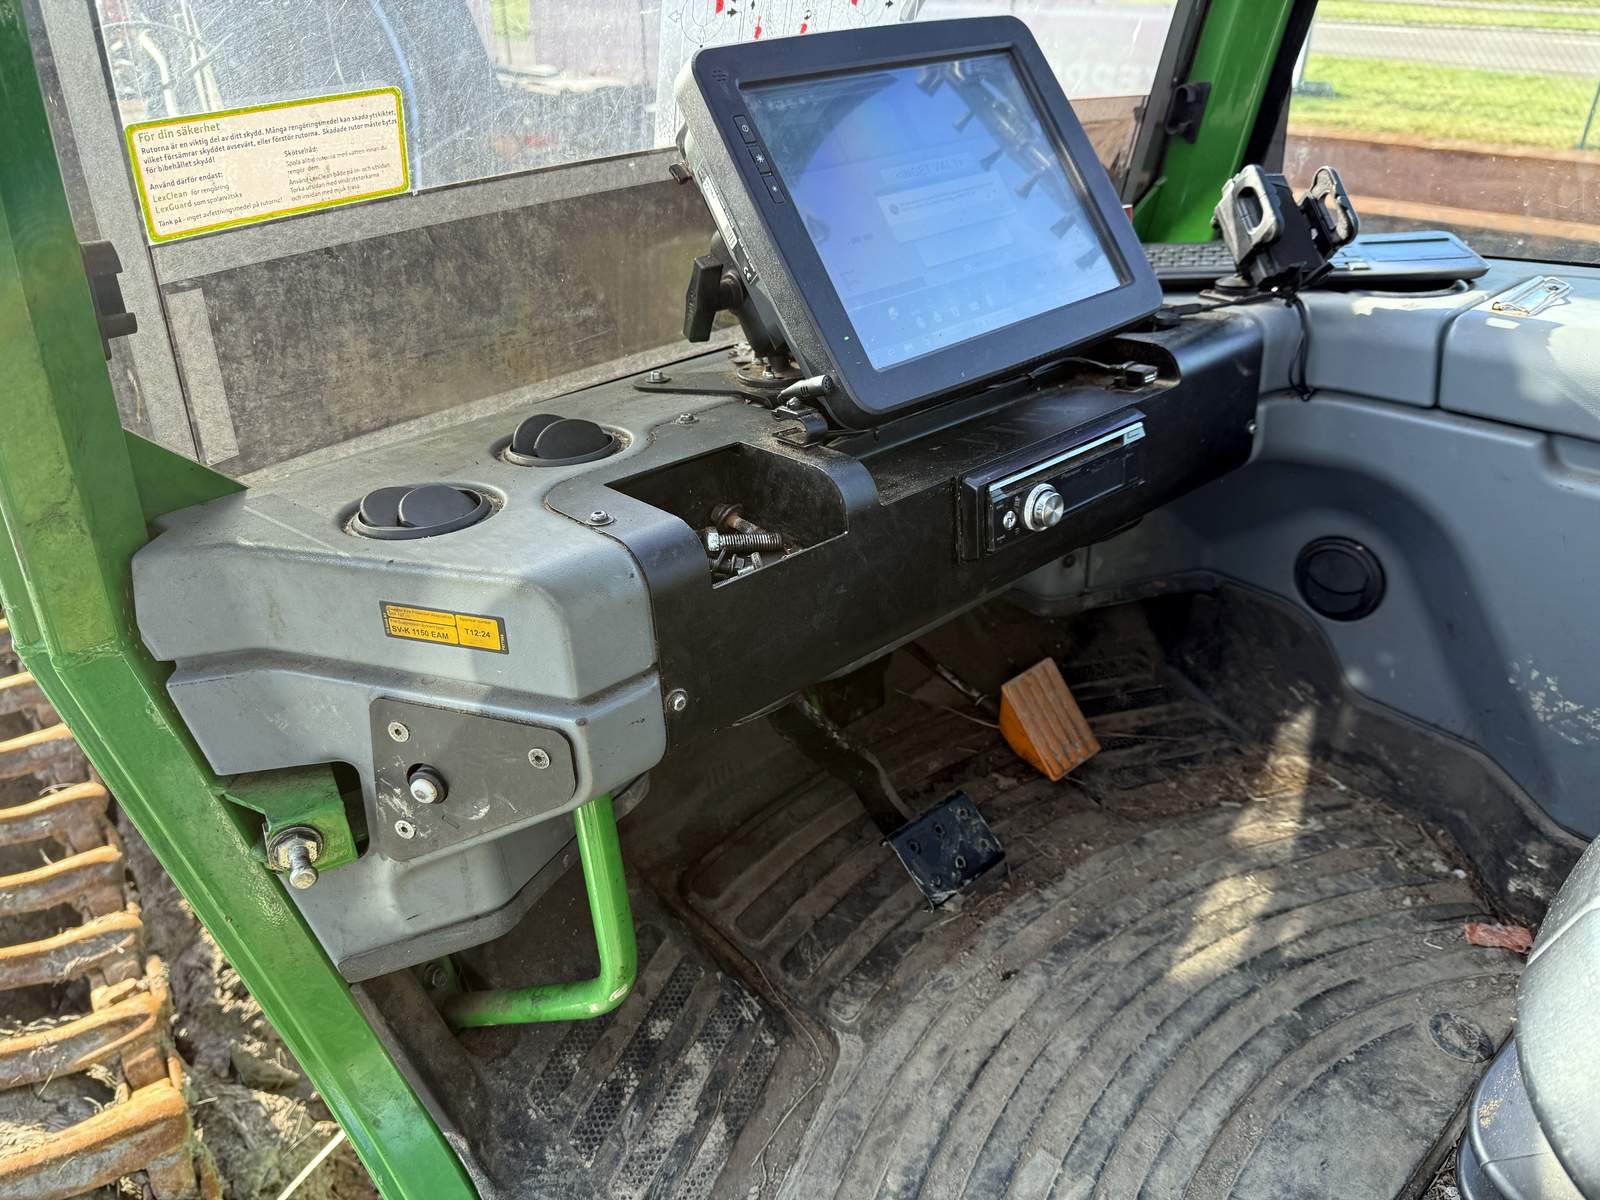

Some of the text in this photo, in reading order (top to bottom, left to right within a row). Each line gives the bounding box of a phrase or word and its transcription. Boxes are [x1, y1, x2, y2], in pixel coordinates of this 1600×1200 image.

[138, 122, 221, 142] För din säkerhet
[141, 144, 169, 154] Rutorna
[189, 138, 208, 148] viktig
[243, 129, 264, 139] skydd.
[265, 125, 287, 135] Många
[289, 118, 339, 132] rengöringsmedel
[144, 155, 163, 164] vilket
[164, 149, 198, 160] försämrar
[199, 145, 225, 156] skyddet
[272, 133, 294, 143] förstör
[322, 126, 347, 135] Skadade
[364, 120, 381, 128] måste
[158, 160, 192, 171] bibehållet
[149, 180, 175, 190] Använd
[176, 176, 198, 185] därför
[153, 190, 187, 202] LexClean
[155, 201, 192, 213] LexGuard
[391, 625, 449, 640] SV-K 1150 EAM
[464, 628, 491, 638] T12:24
